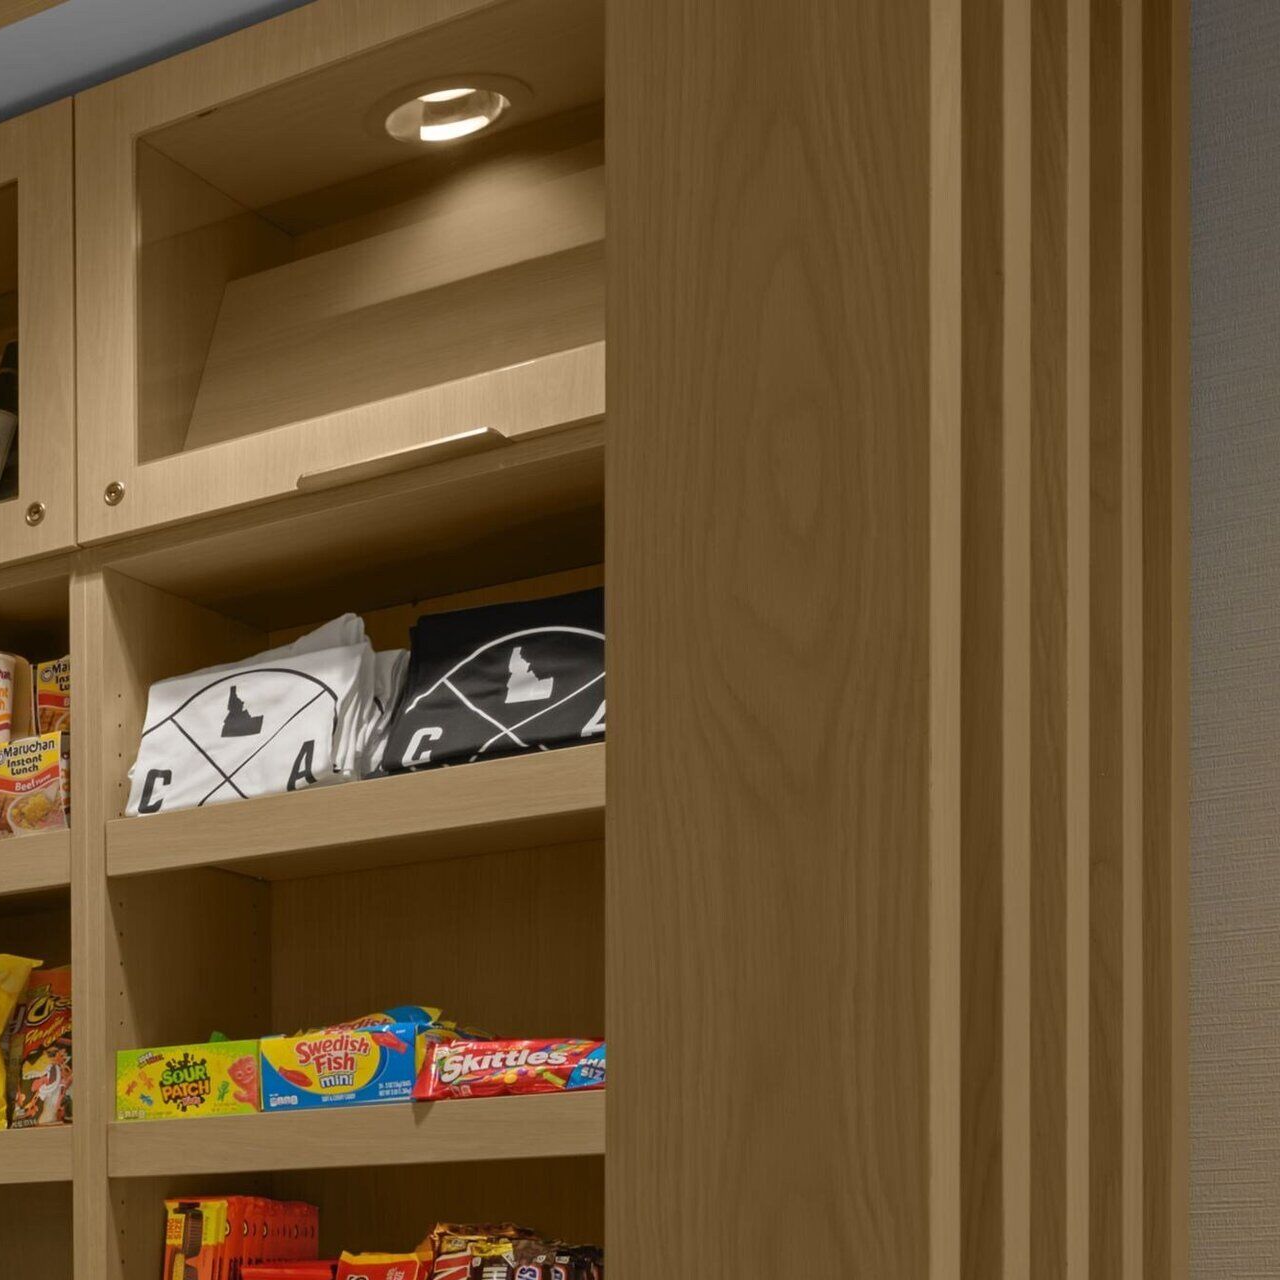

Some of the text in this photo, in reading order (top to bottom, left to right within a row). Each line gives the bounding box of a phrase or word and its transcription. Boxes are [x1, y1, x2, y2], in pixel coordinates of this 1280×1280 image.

[4, 739, 55, 757] Maruchan
[401, 726, 443, 767] C
[7, 754, 42, 768] Instant
[11, 764, 38, 776] Lunch
[287, 740, 317, 791] A
[15, 779, 35, 791] Beef
[138, 769, 172, 813] C
[295, 1034, 371, 1064] Swedish
[313, 1052, 356, 1073] Fish
[440, 1051, 567, 1083] Skittles
[162, 1063, 208, 1086] SOUR
[319, 1074, 354, 1088] mini
[580, 1069, 605, 1080] SIZ
[162, 1080, 210, 1100] PATCH
